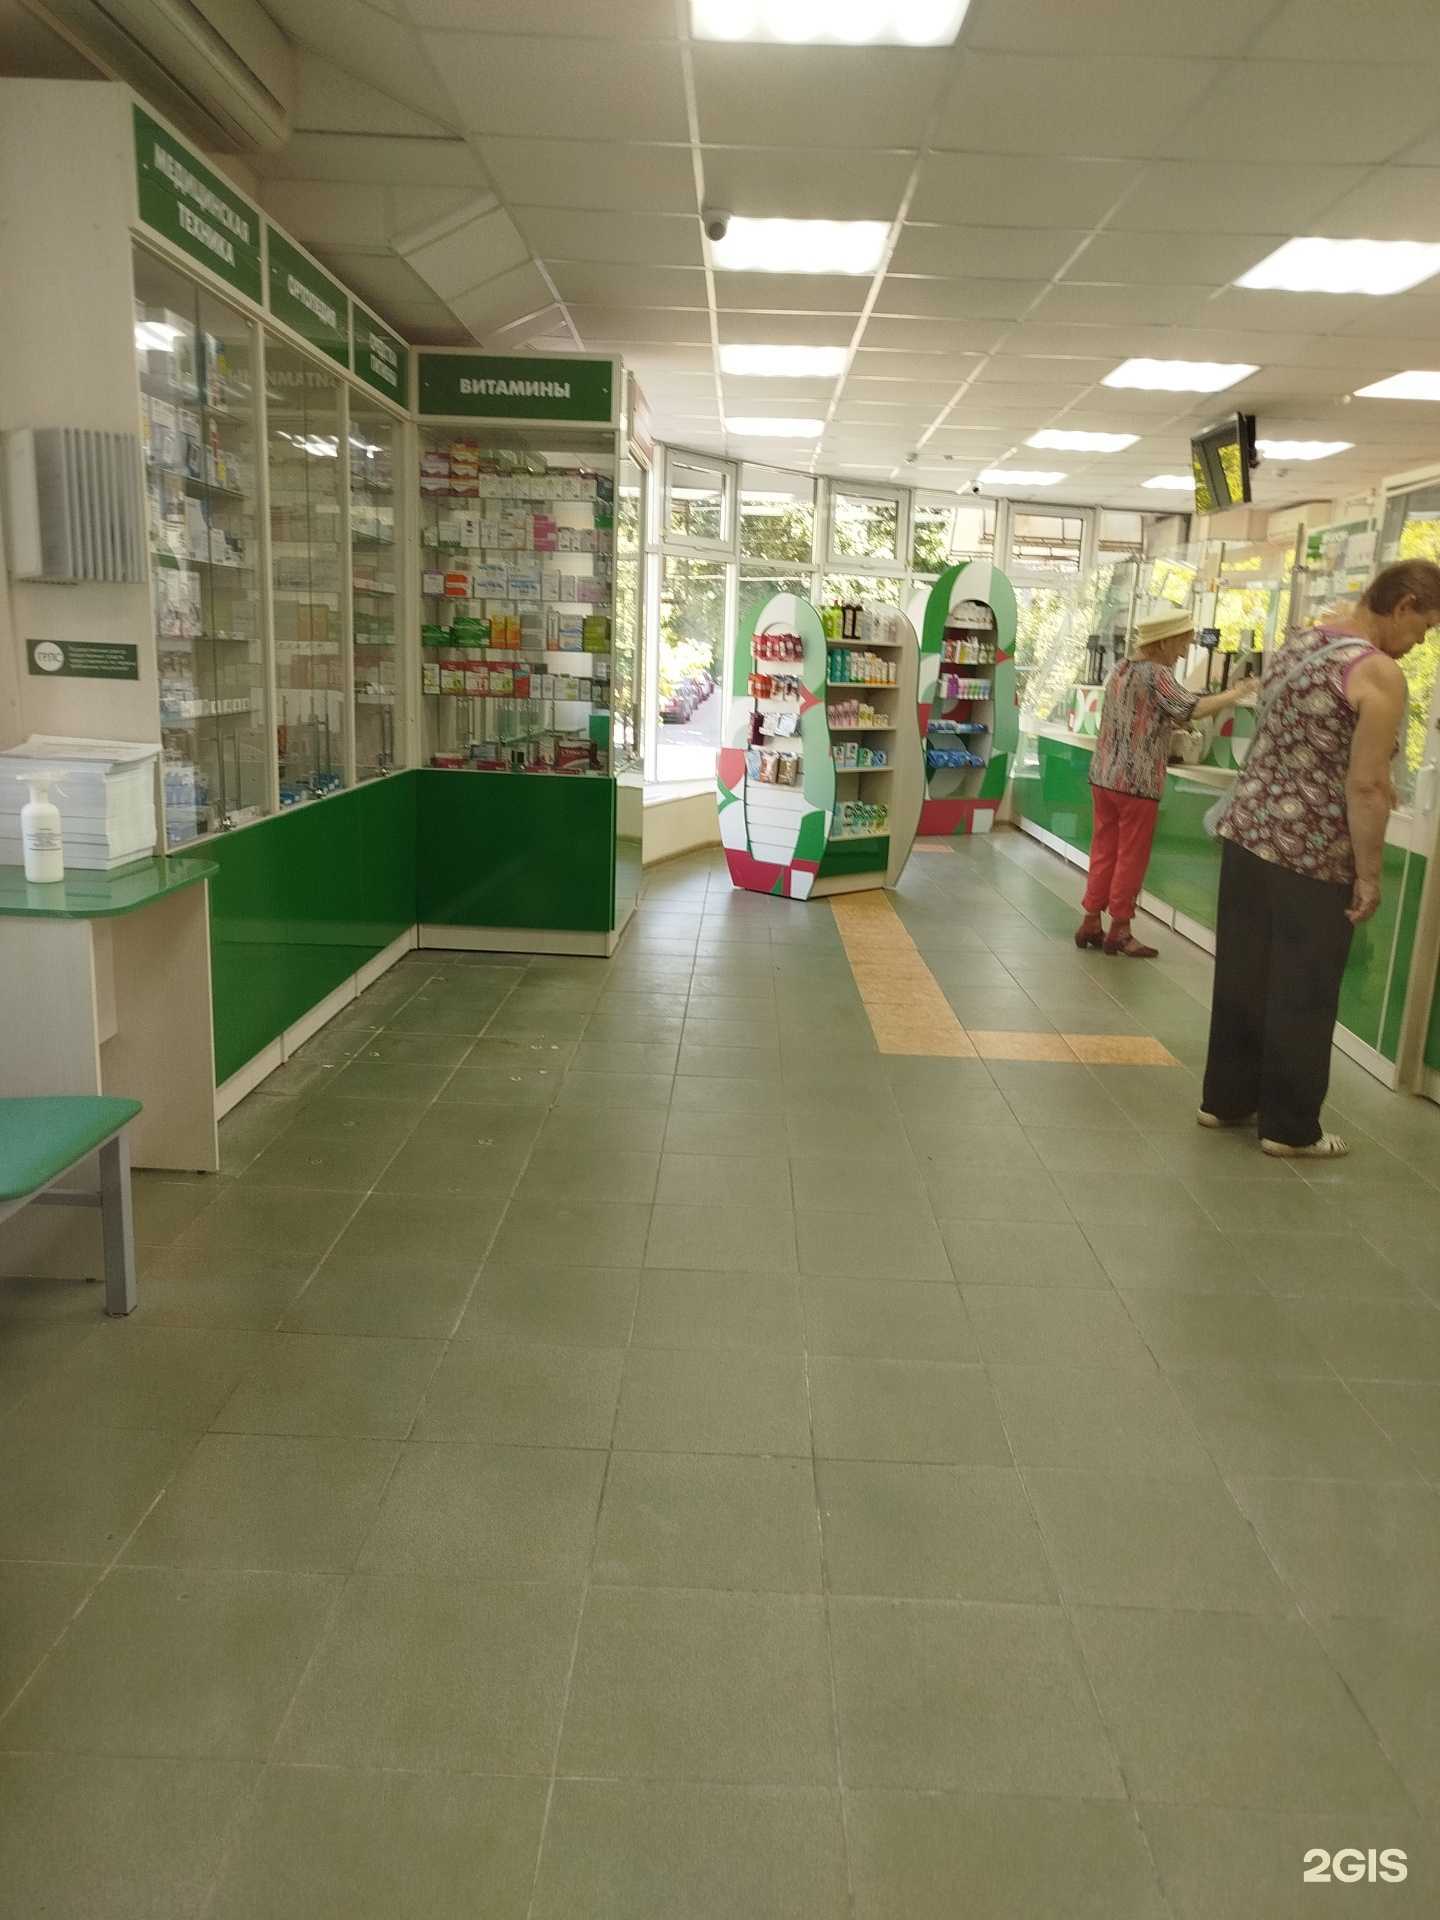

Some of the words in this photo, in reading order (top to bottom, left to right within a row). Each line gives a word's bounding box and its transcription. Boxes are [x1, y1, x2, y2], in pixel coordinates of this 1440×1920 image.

[153, 141, 250, 245] МЕДИЦИНСКАЯ
[177, 200, 236, 268] ТЕХНИКА
[459, 378, 570, 399] ВИТАМИНЫ
